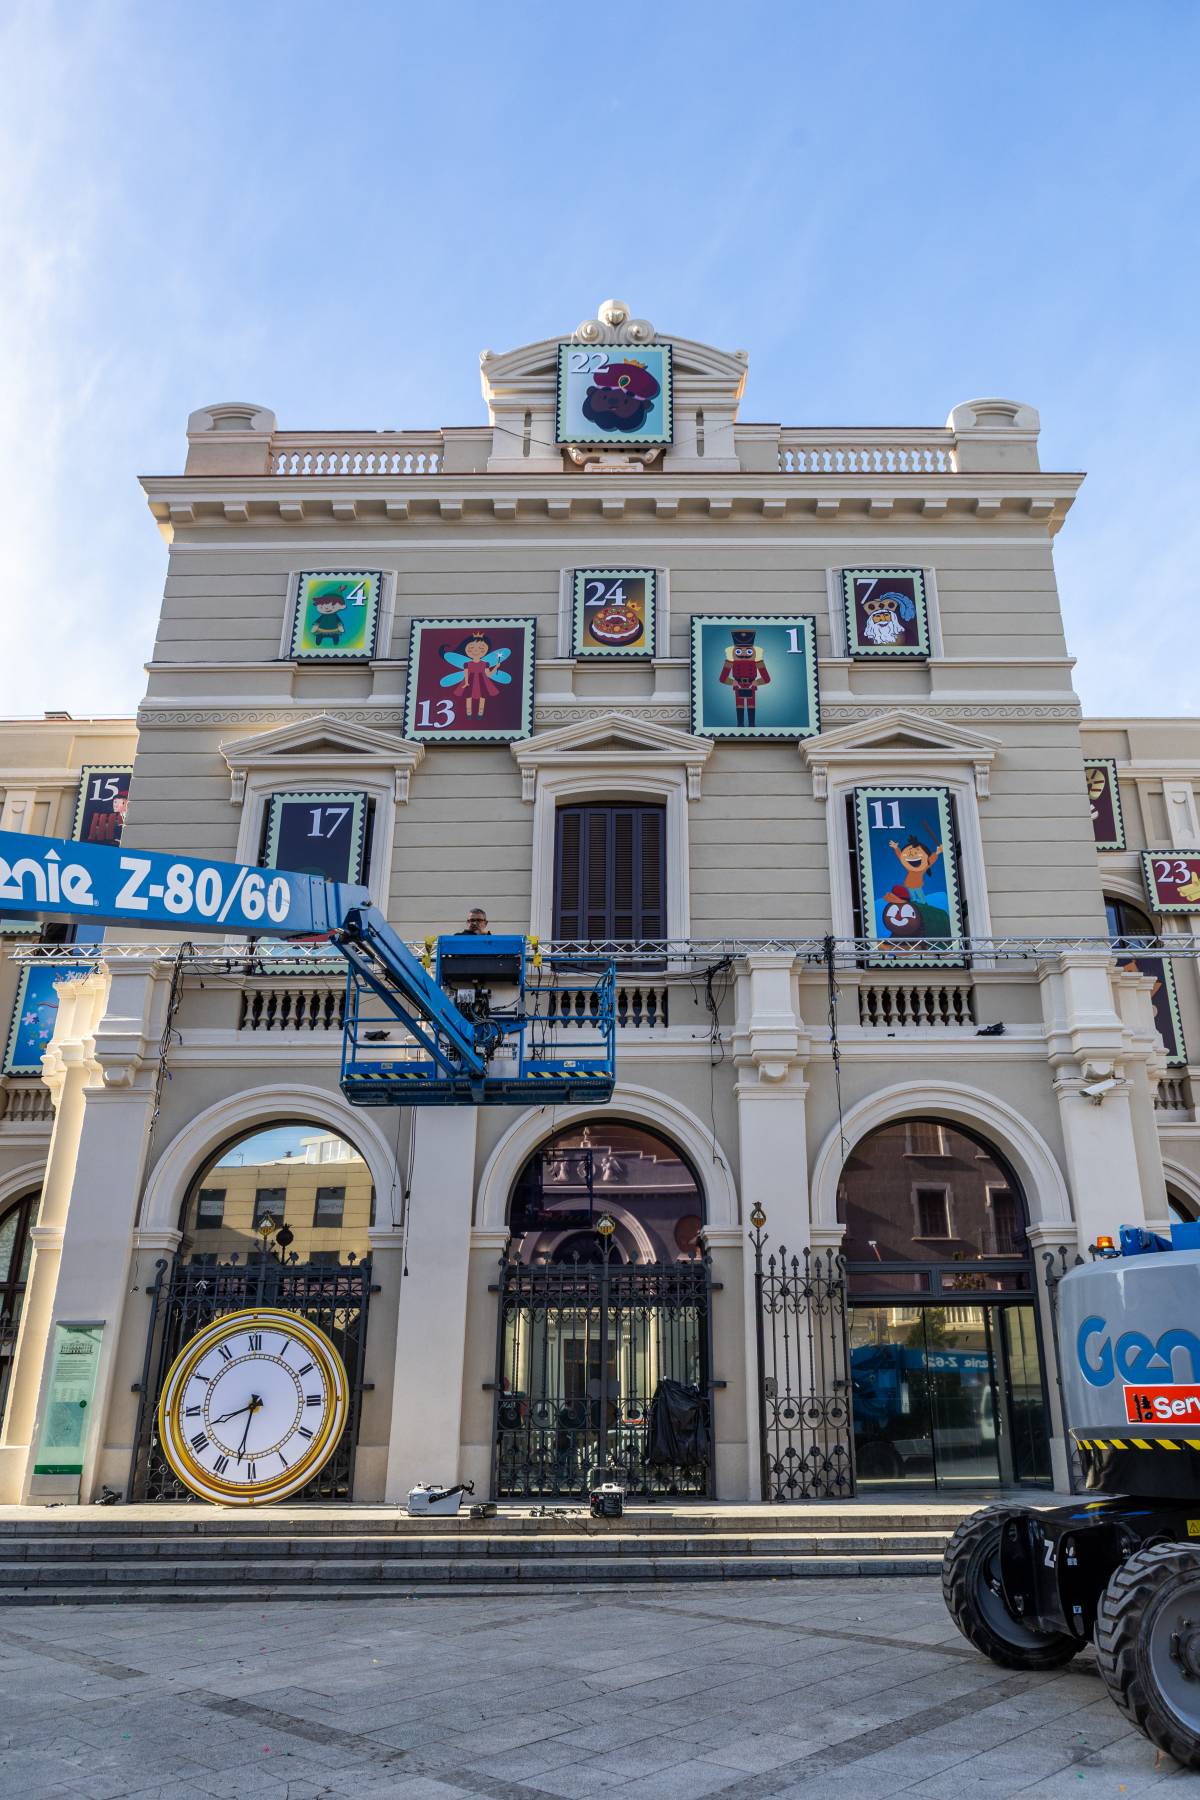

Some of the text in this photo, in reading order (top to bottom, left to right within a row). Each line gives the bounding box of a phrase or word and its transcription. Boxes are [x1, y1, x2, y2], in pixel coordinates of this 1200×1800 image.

[571, 353, 610, 373] 22
[346, 581, 367, 606] 4
[585, 579, 627, 606] 24
[856, 579, 878, 605] 7
[785, 628, 802, 653] 1
[417, 699, 456, 728] 13
[90, 777, 119, 801] 15
[307, 808, 350, 838] 17
[870, 800, 905, 829] 11
[1155, 861, 1190, 883] 23
[115, 856, 291, 923] Z-80/60
[248, 1335, 262, 1351] XII
